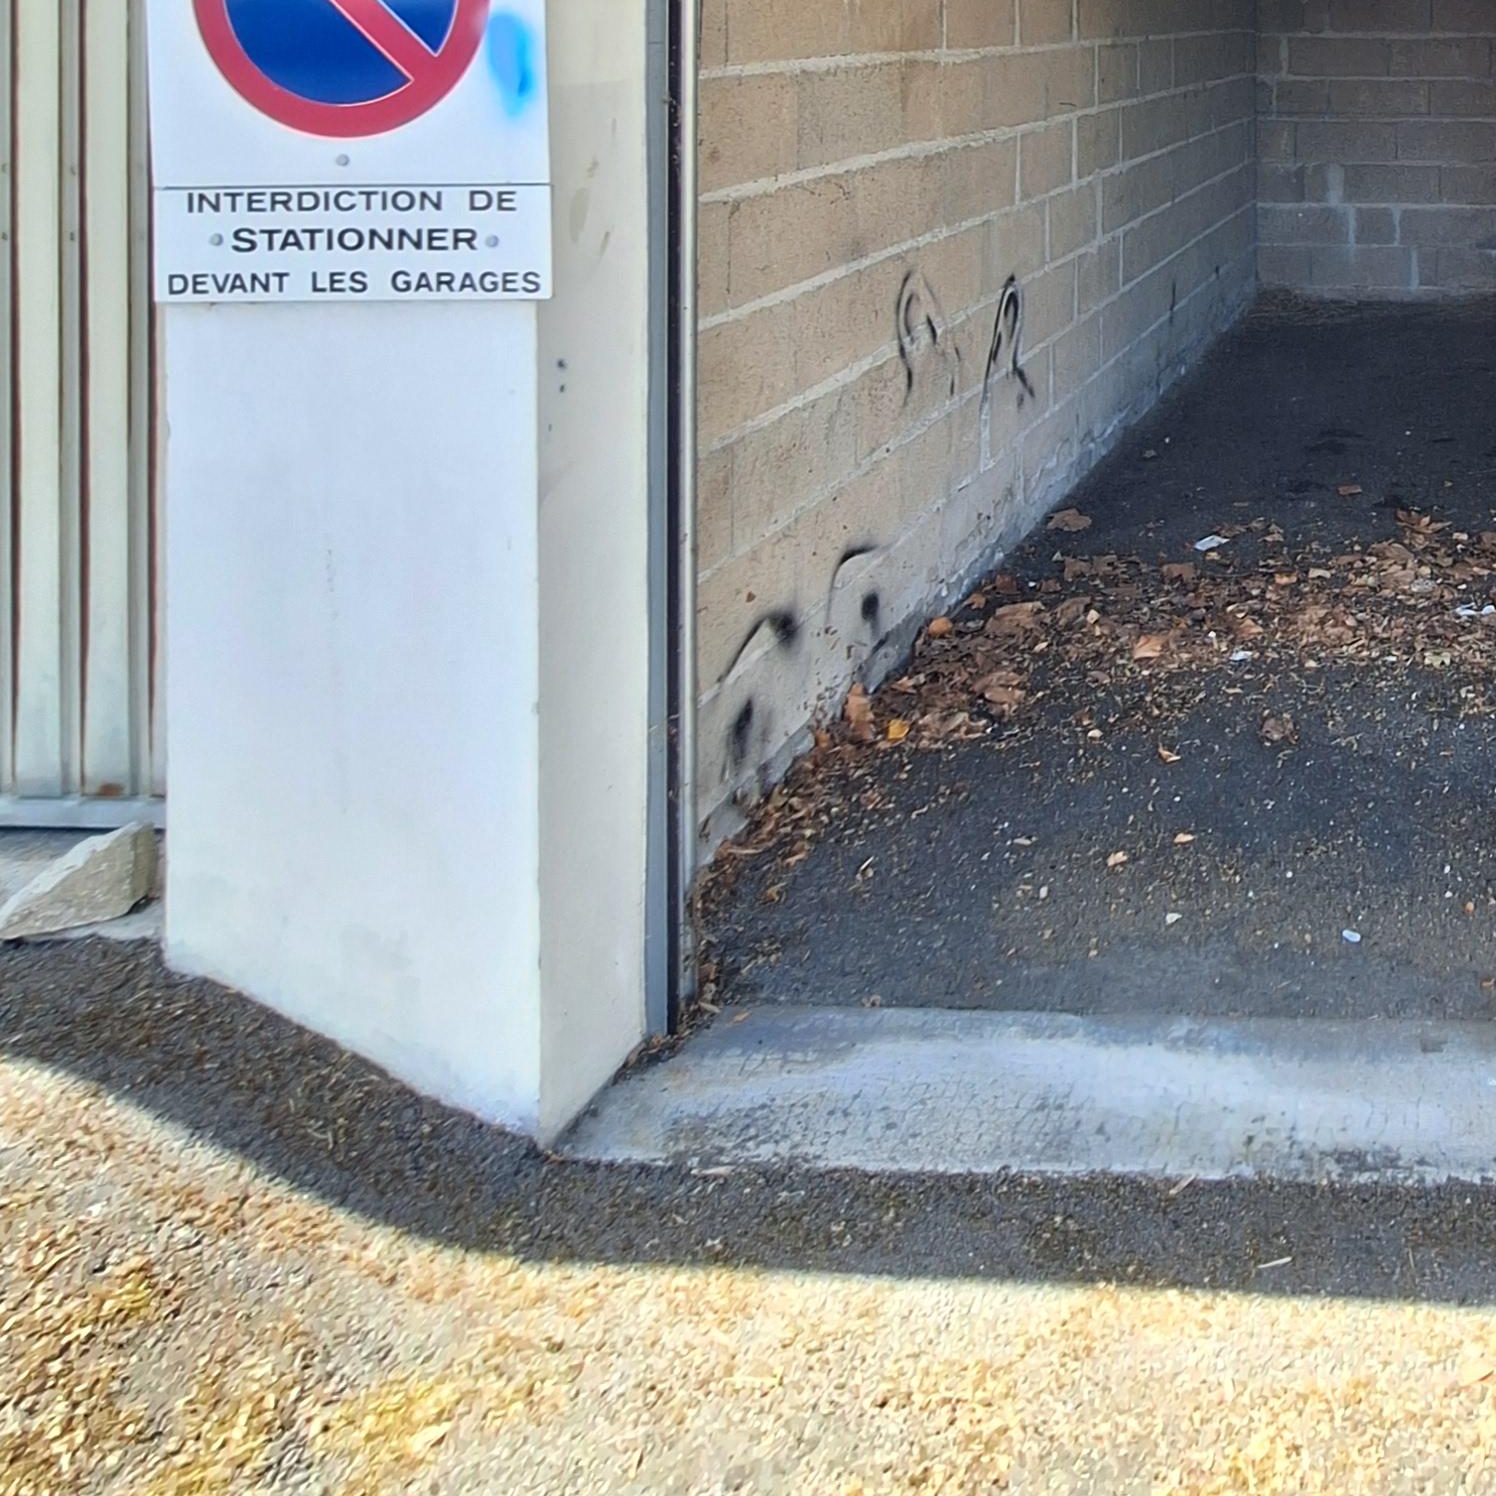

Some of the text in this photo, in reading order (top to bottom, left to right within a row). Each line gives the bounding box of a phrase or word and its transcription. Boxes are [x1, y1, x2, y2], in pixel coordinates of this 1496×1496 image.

[187, 189, 517, 214] INTERDICTION DE
[231, 227, 477, 253] STATIONNER
[168, 270, 540, 296] DEVANT LES GARAGES
